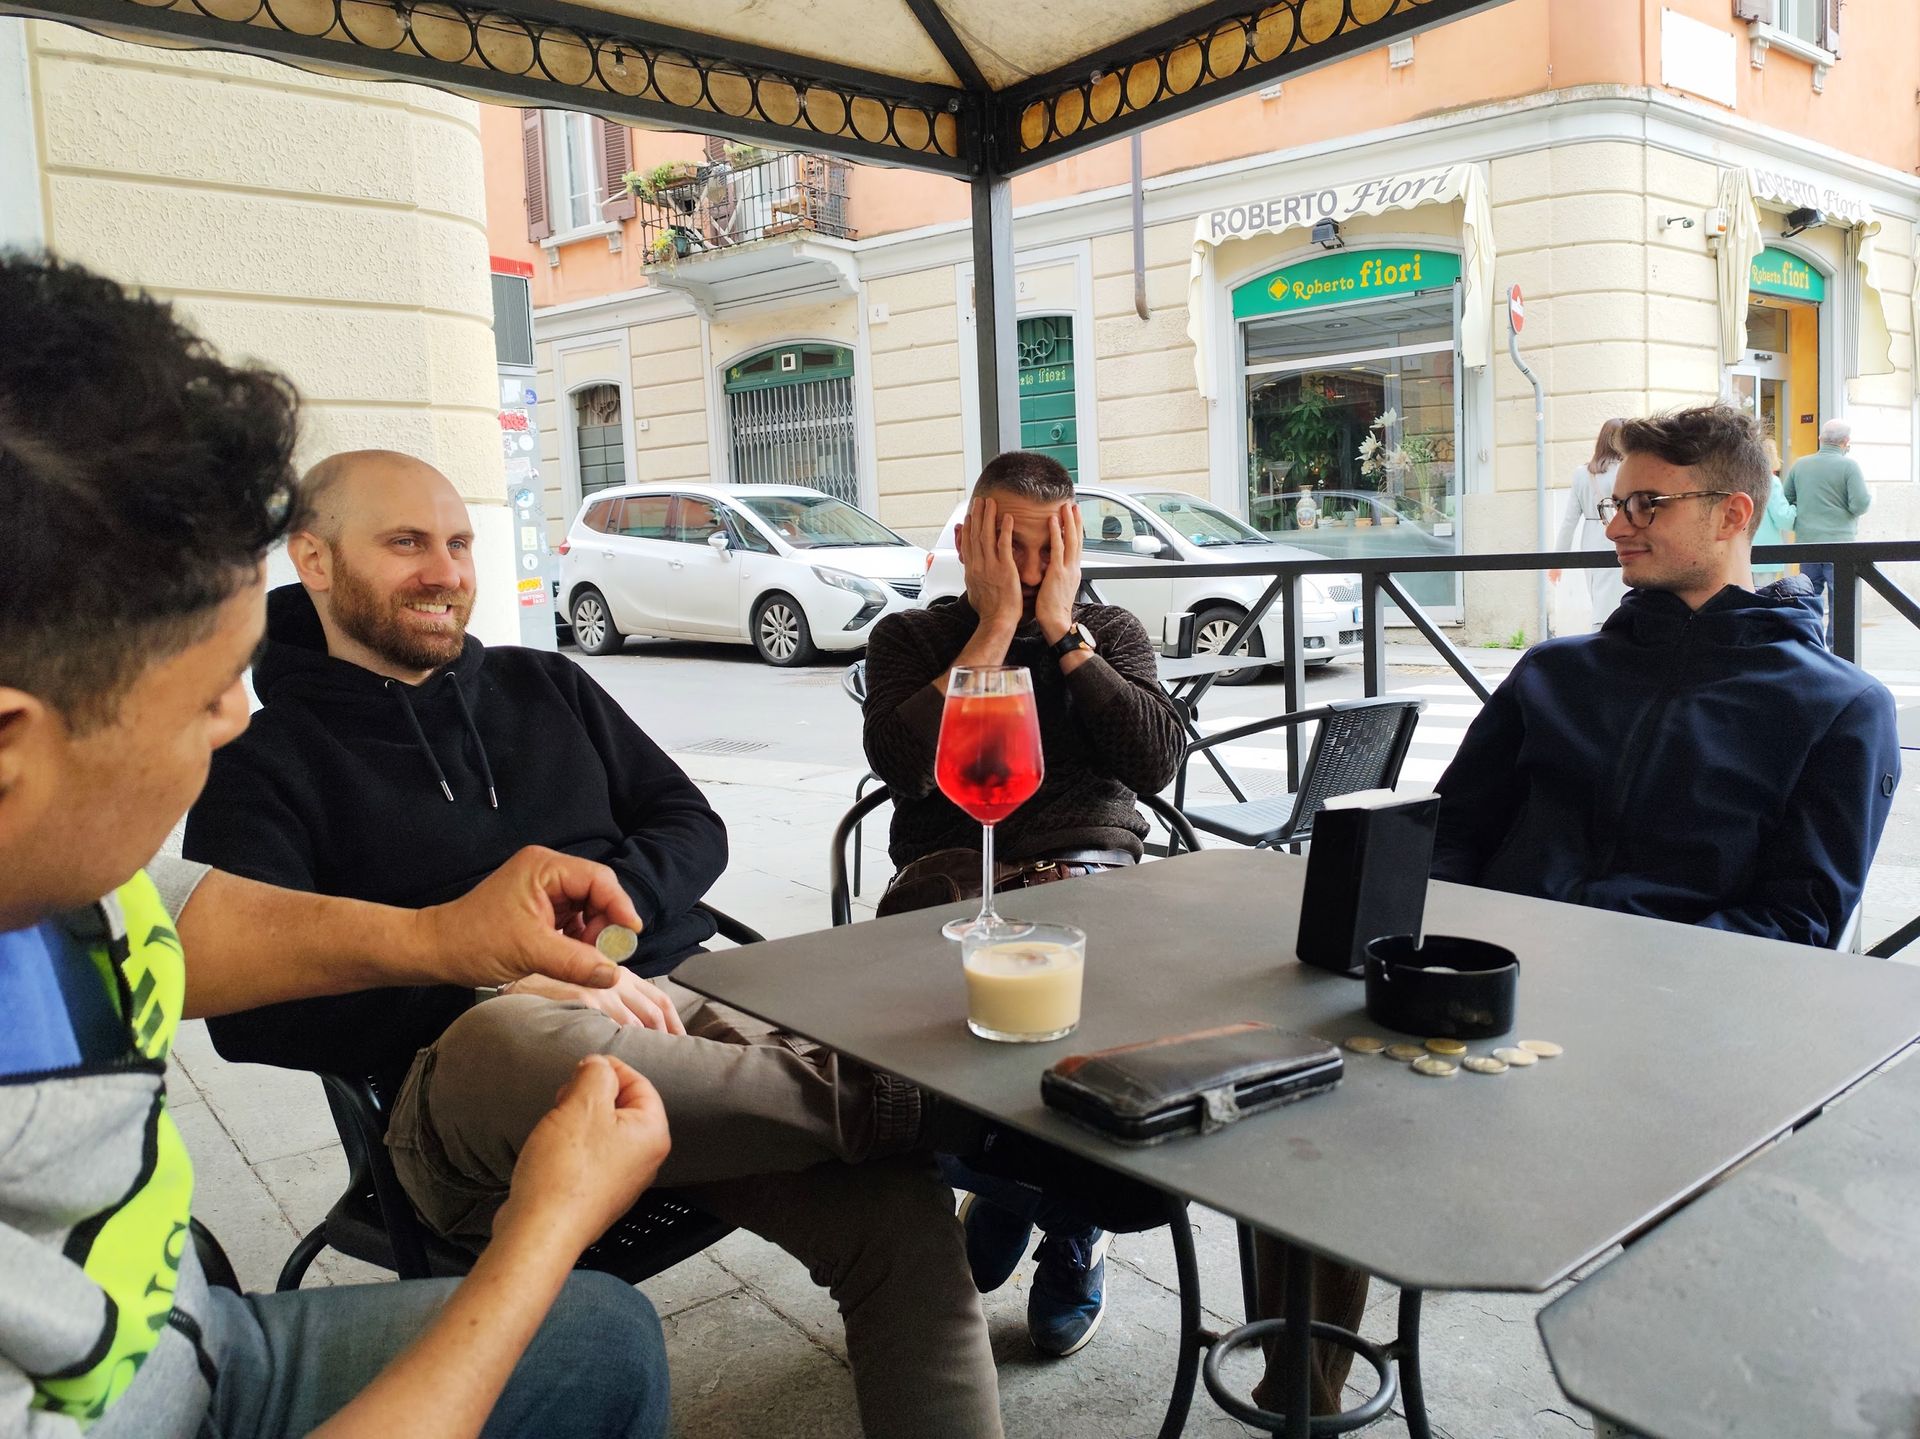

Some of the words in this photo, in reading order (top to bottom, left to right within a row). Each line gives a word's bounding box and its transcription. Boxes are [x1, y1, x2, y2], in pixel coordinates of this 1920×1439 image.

[1211, 189, 1338, 238] ROBERTO
[1344, 166, 1454, 214] Fiori
[1754, 168, 1818, 208] ROBERTO
[1823, 189, 1866, 218] Fiori
[1292, 278, 1354, 300] Roberto
[1360, 254, 1422, 287] fiori
[1752, 265, 1780, 285] Roberto
[1782, 261, 1810, 289] fiori
[1038, 367, 1066, 384] fiori
